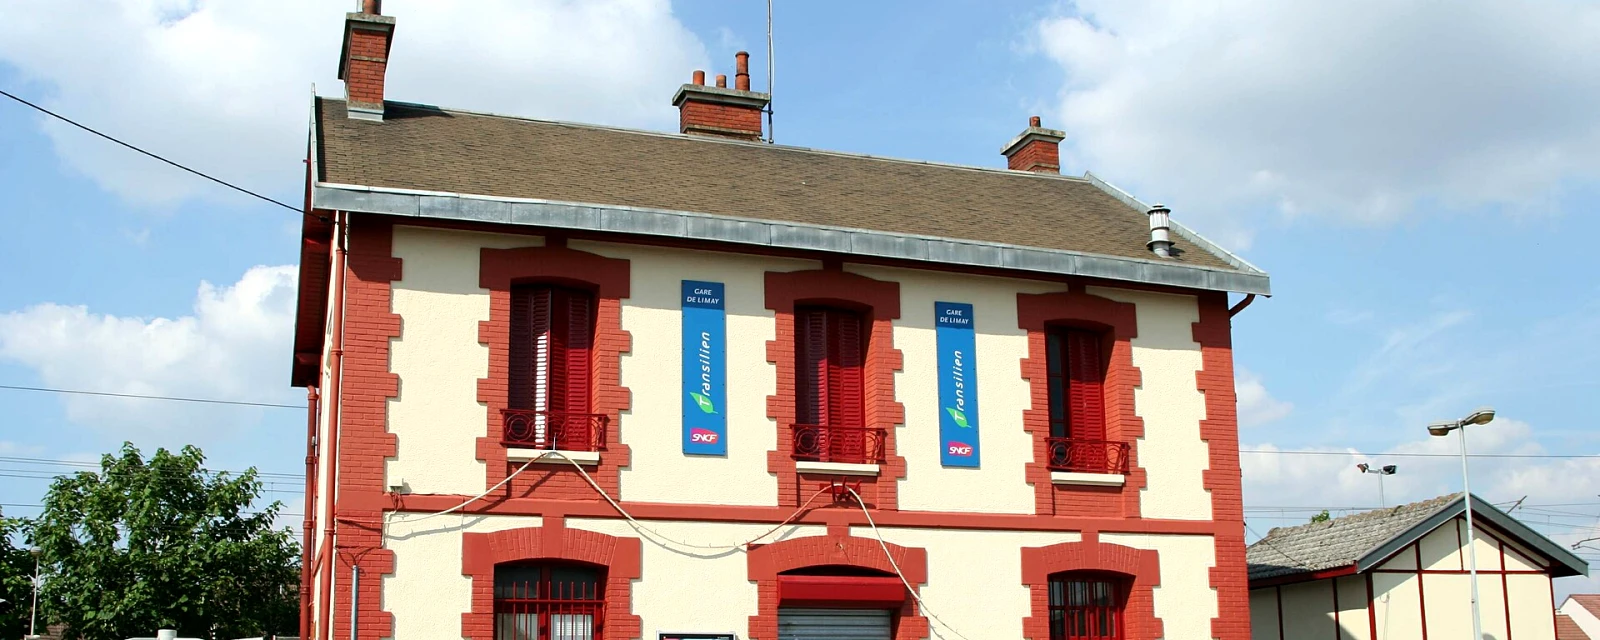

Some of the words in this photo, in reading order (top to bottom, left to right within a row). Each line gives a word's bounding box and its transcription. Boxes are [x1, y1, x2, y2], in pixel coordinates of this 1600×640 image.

[694, 288, 712, 296] GARE
[697, 296, 720, 304] LIMAY
[949, 317, 969, 325] LIMAY
[699, 332, 711, 406] Transilien
[953, 350, 964, 421] Transilien
[691, 433, 718, 443] SNCF
[949, 446, 971, 455] SNCF
